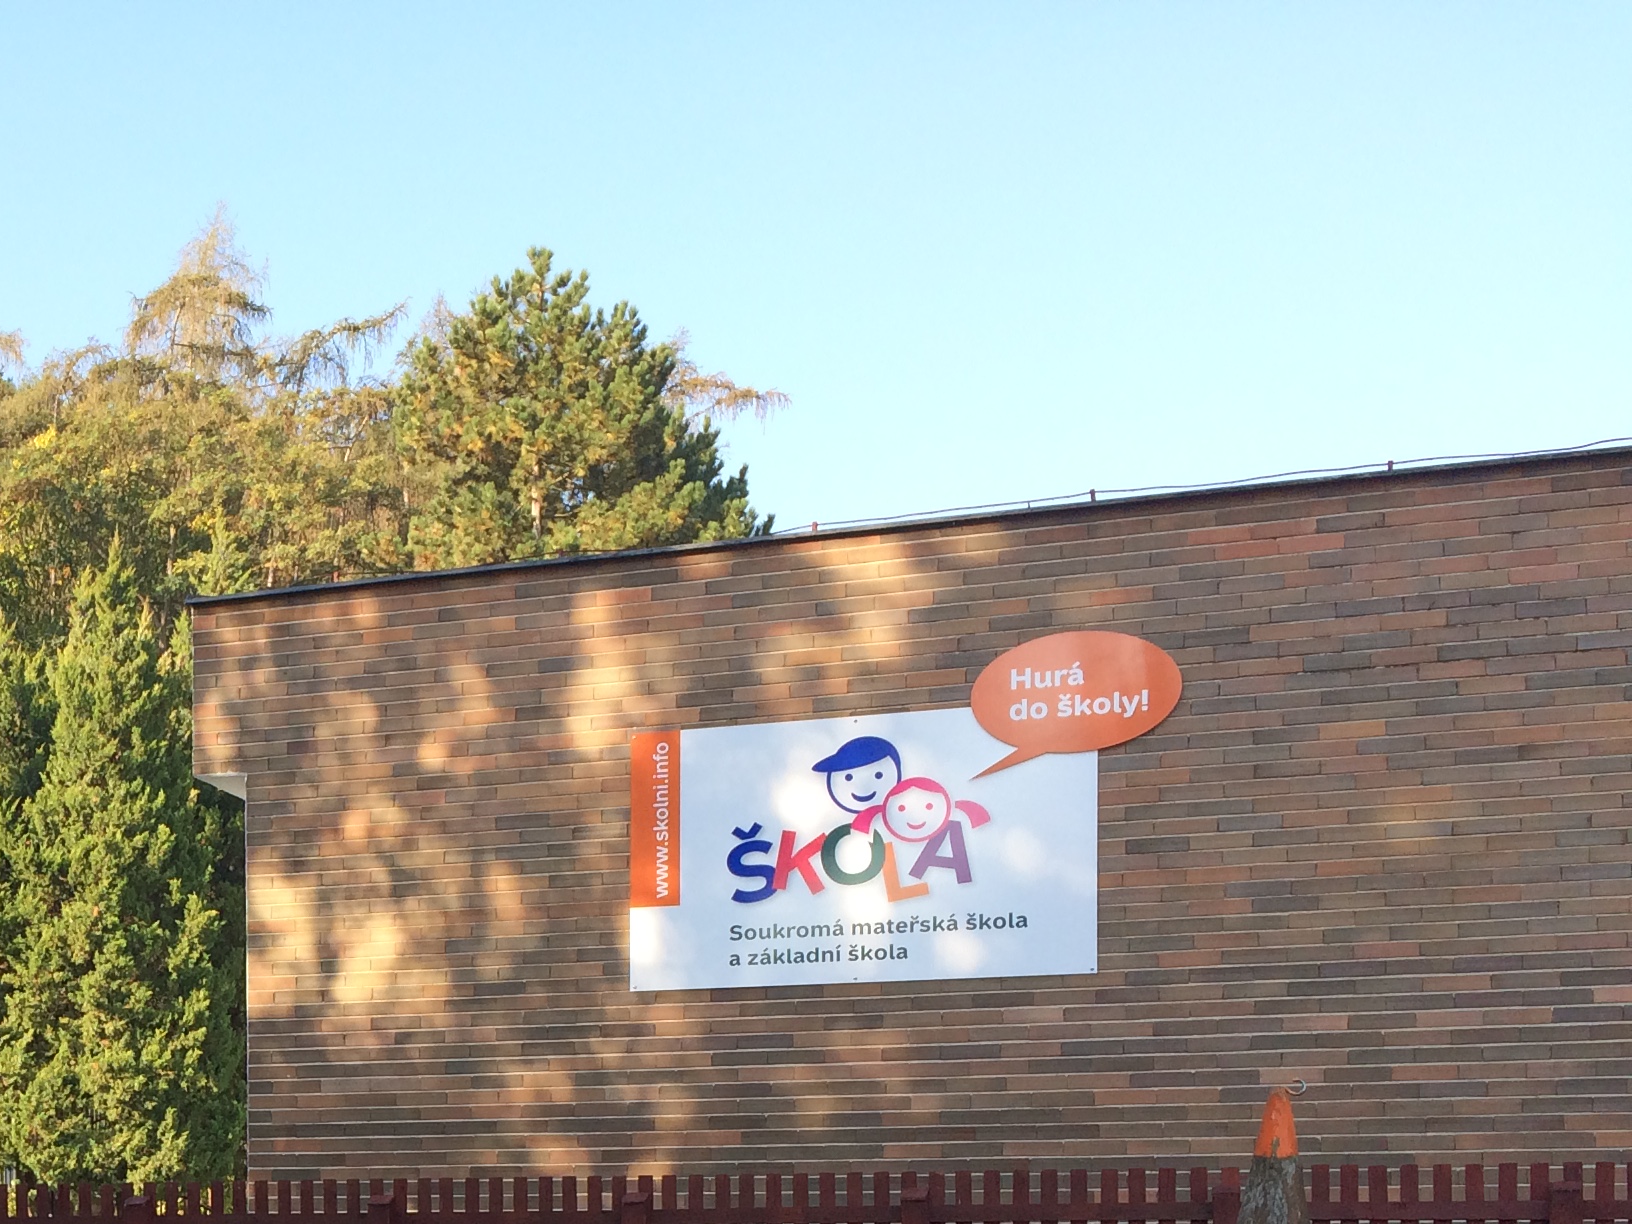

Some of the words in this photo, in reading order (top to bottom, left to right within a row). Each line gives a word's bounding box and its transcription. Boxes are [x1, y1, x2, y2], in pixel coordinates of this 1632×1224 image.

[1010, 661, 1085, 690] Hurá
[1009, 699, 1048, 721] do
[1057, 689, 1149, 718] školy!
[652, 742, 669, 899] www.skolni.info
[726, 820, 973, 903] ŠKOLA
[729, 919, 844, 941] Soukromá
[851, 915, 959, 936] mateřská
[965, 912, 1029, 931] škola
[729, 954, 741, 966] a
[747, 944, 841, 966] základní
[848, 944, 909, 962] škola
